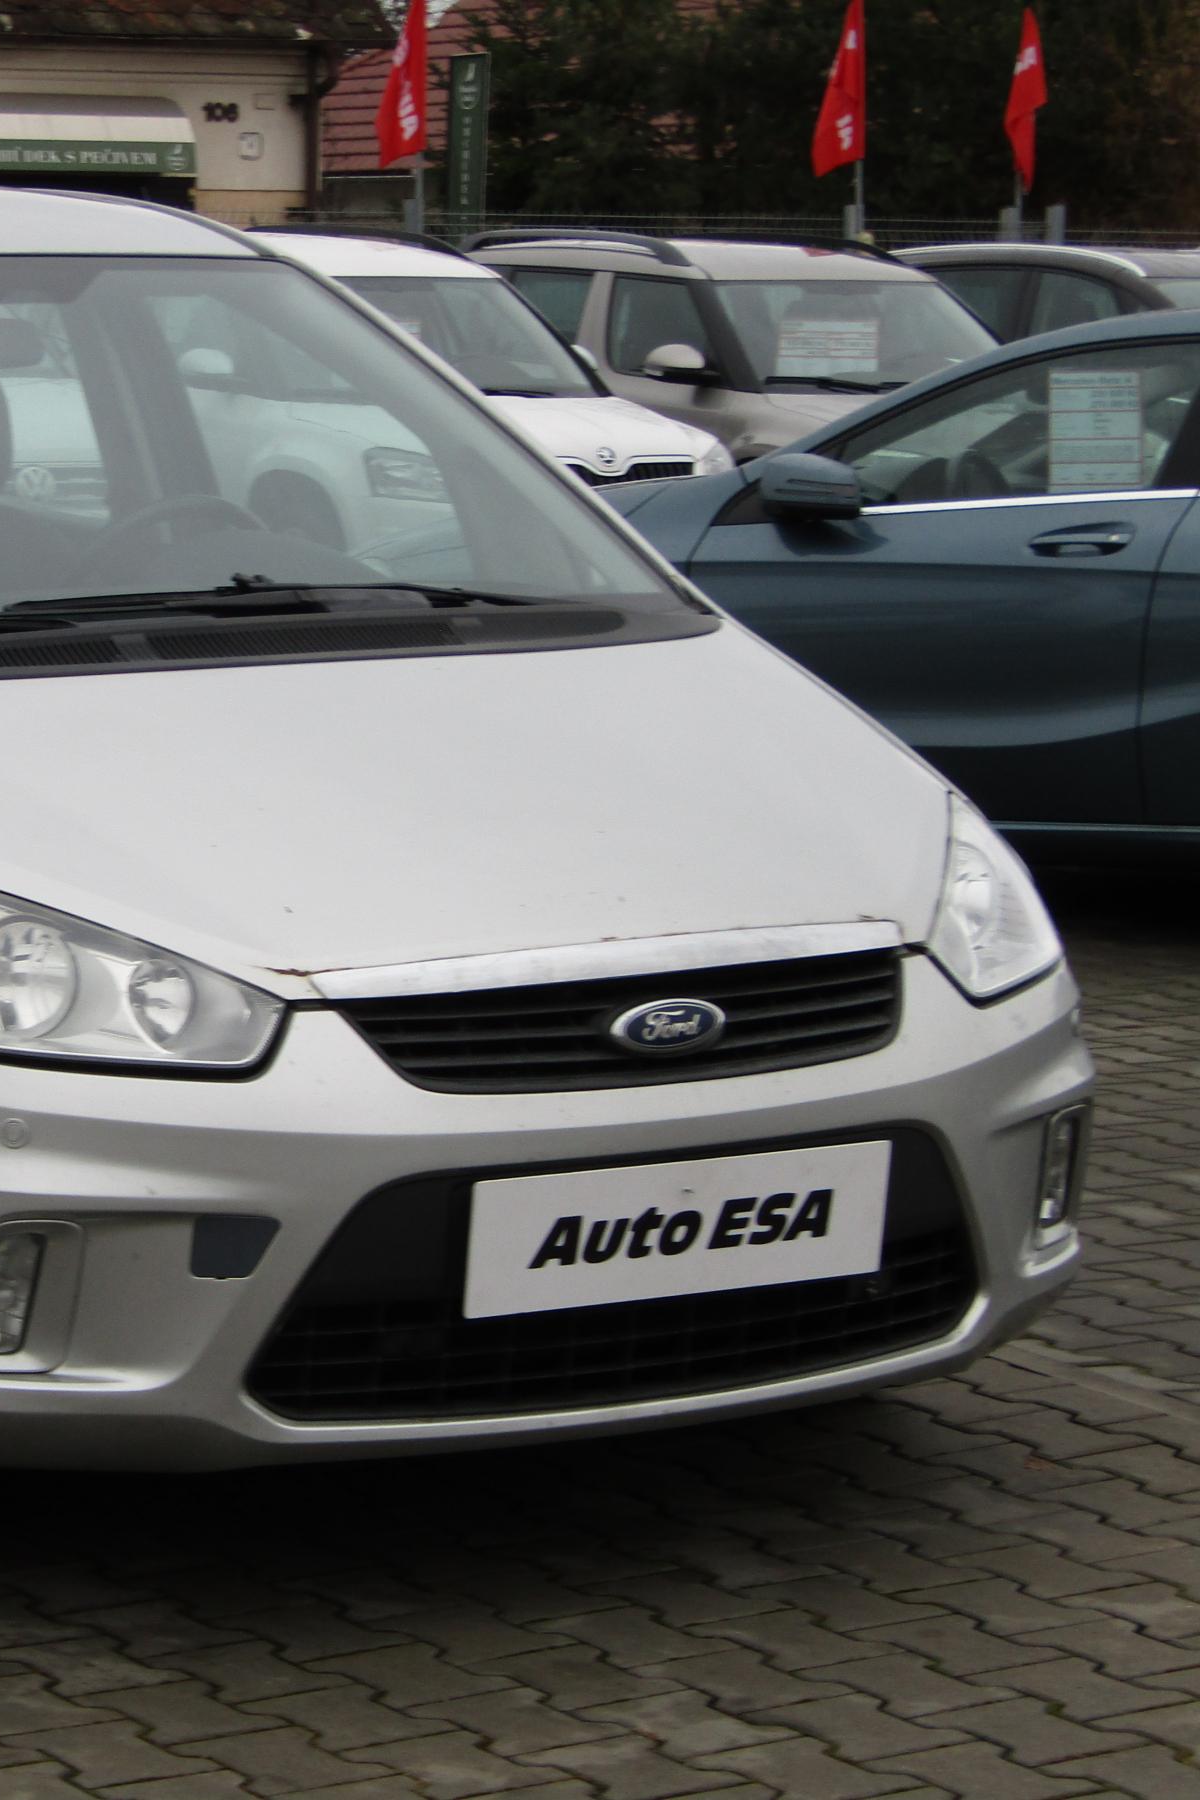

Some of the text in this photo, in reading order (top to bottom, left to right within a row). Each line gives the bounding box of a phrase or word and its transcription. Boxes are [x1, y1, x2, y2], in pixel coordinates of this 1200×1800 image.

[202, 103, 239, 123] 106
[641, 1009, 701, 1041] Ford
[527, 1188, 834, 1269] Auto ESA
